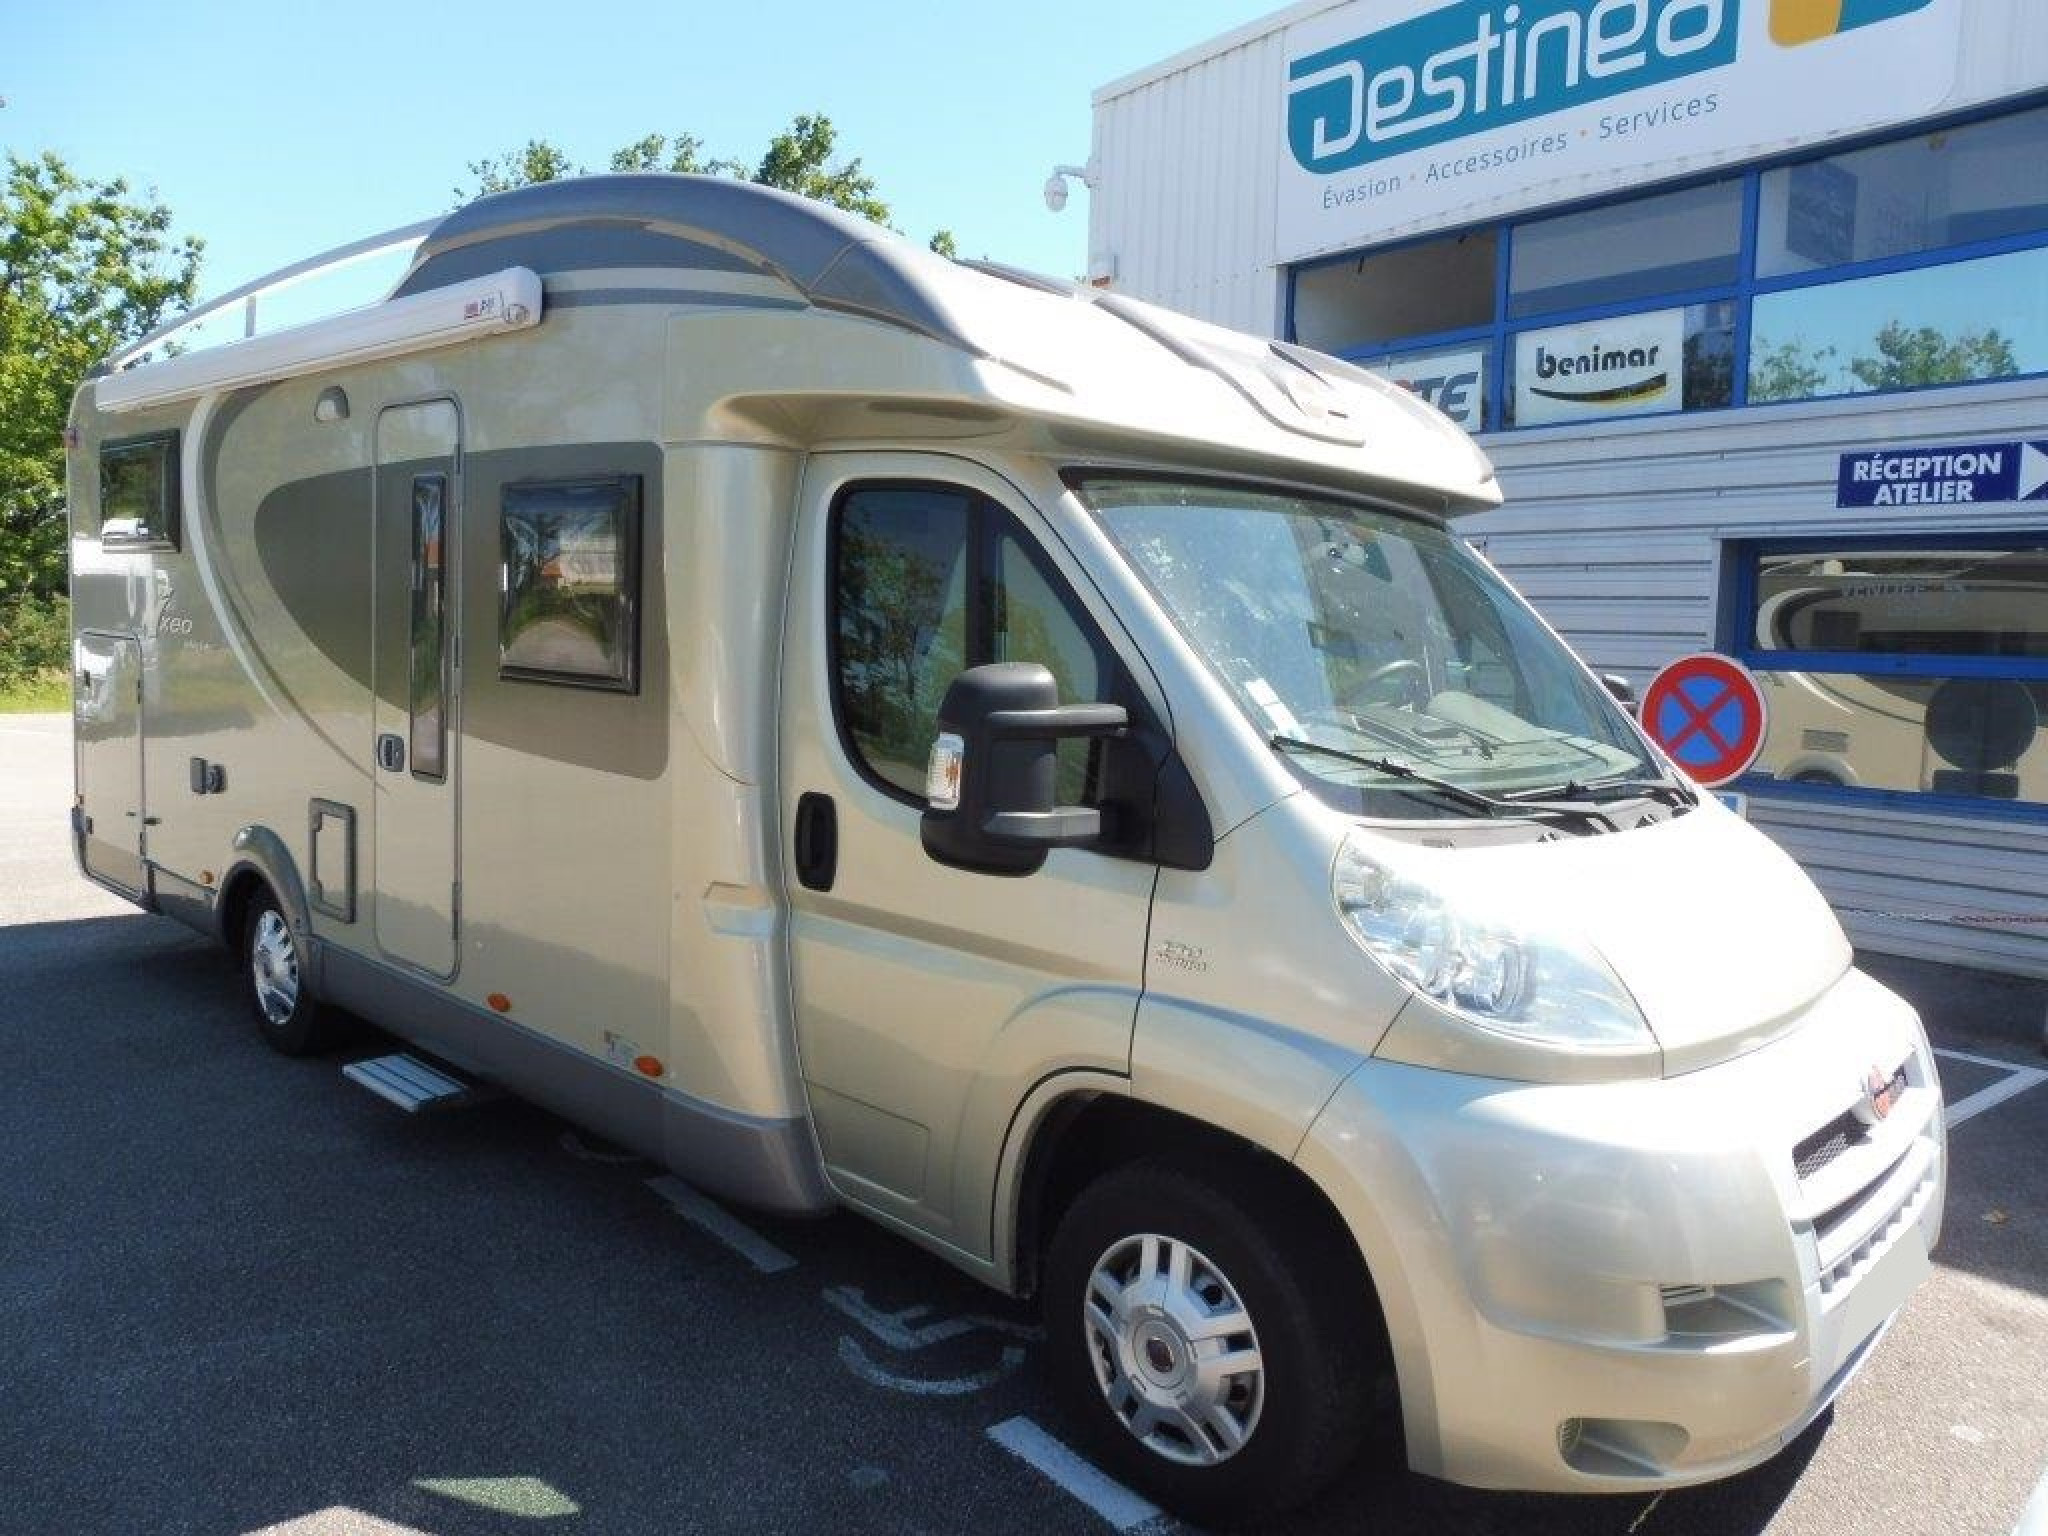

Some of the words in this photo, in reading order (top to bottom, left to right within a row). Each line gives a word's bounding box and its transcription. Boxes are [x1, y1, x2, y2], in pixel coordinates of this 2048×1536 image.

[1288, 0, 1723, 160] Destineo
[1322, 174, 1401, 209] Évasion
[1425, 132, 1568, 183] Accessoires
[1599, 93, 1718, 139] Services
[1535, 344, 1659, 379] benimar
[1393, 371, 1479, 423] TE
[1853, 451, 2002, 481] RÉCEPTION
[1873, 481, 1974, 505] ATELIER
